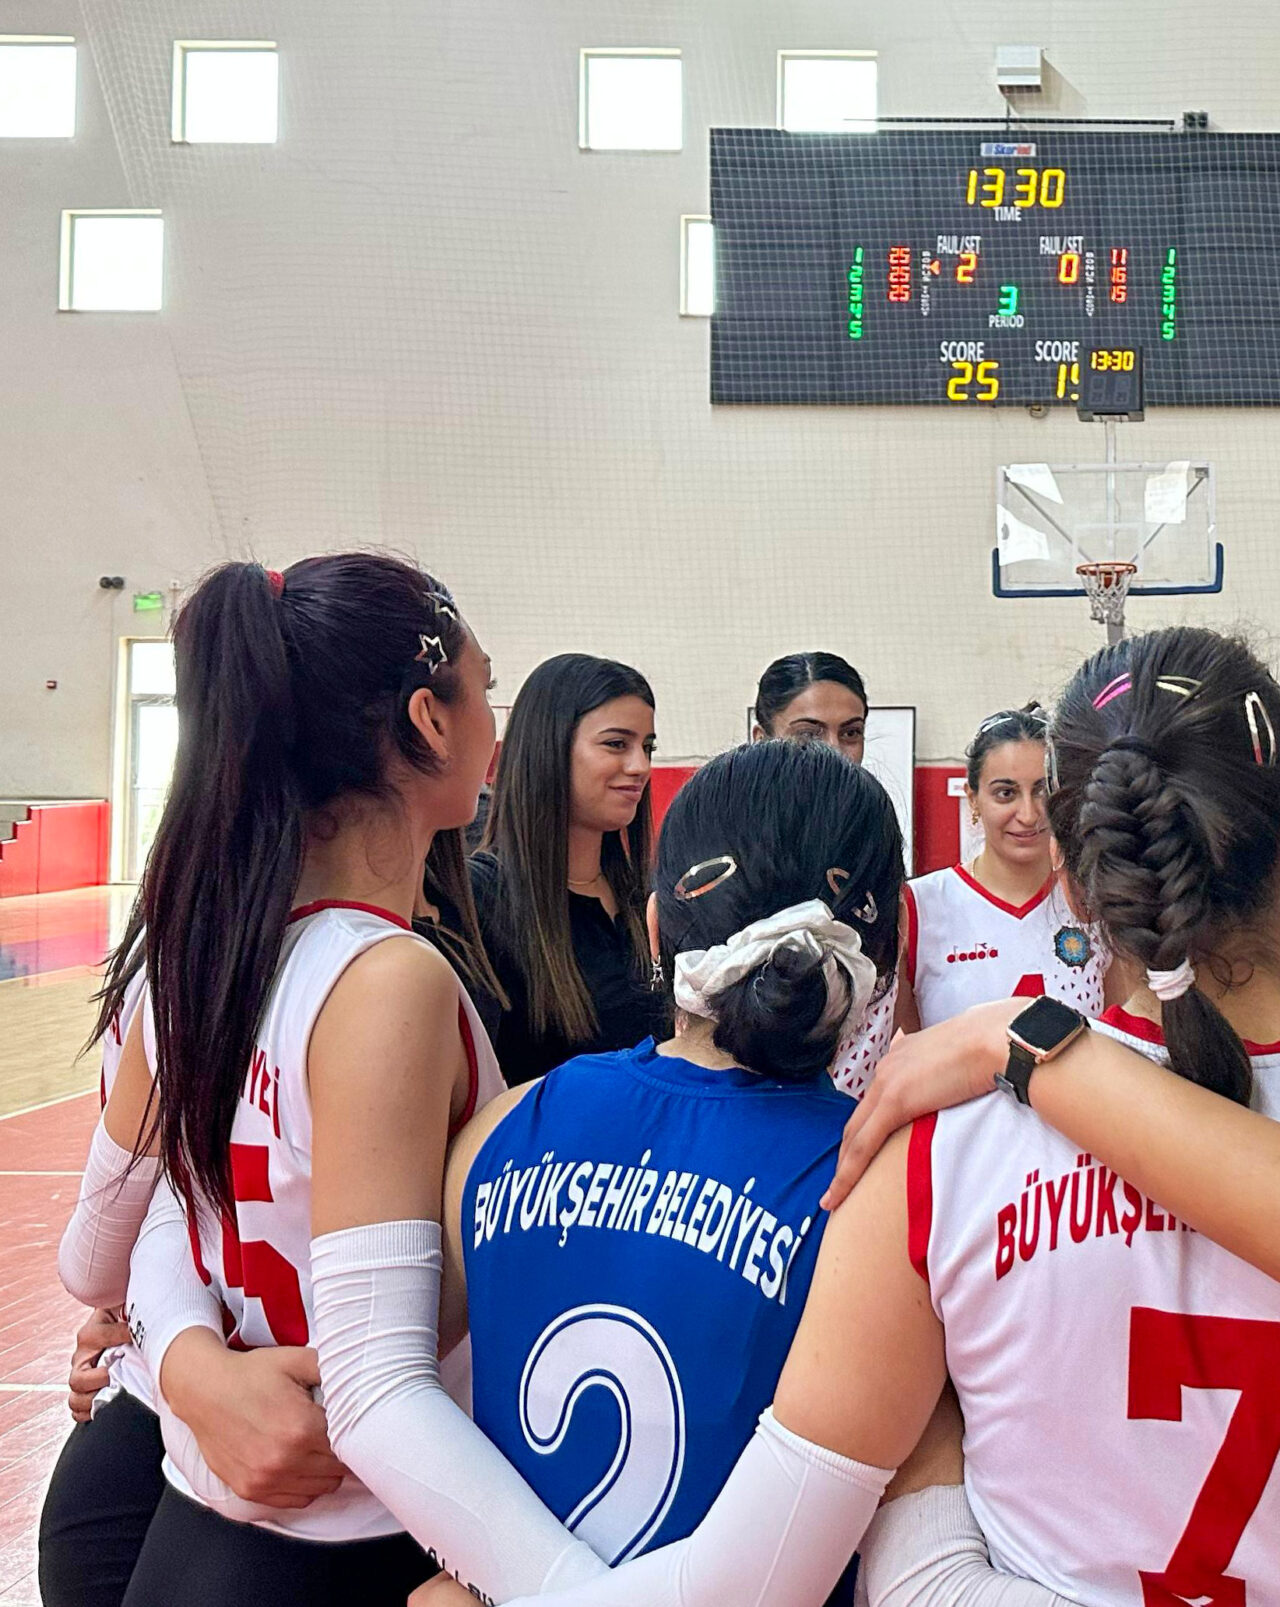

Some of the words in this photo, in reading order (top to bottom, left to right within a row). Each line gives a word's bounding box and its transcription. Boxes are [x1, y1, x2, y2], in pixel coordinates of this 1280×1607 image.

[993, 206, 1022, 221] TIME
[855, 247, 863, 263] 1
[889, 247, 910, 264] 25
[1111, 248, 1127, 265] 11
[1168, 248, 1176, 265] 1
[850, 265, 863, 283] 2
[889, 265, 910, 282] 25
[957, 253, 977, 282] 2
[1059, 253, 1079, 283] 0
[1110, 266, 1127, 283] 16
[1162, 266, 1176, 283] 2
[850, 284, 863, 301] 3
[888, 284, 910, 302] 25
[998, 285, 1018, 316] 3
[1110, 285, 1127, 302] 15
[1162, 285, 1175, 303] 3
[850, 302, 863, 319] 4
[1162, 304, 1175, 320] 4
[849, 320, 863, 338] 5
[989, 314, 1025, 328] PERIOD
[1162, 321, 1175, 340] 5
[940, 341, 985, 362] SCORE
[1035, 340, 1080, 362] SCORE
[1091, 350, 1135, 371] 13:30
[947, 361, 999, 401] 25
[474, 1149, 659, 1251] BÜYÜKŞEHİR
[646, 1170, 812, 1306] BELEDİYESİ
[519, 1303, 686, 1569] 2
